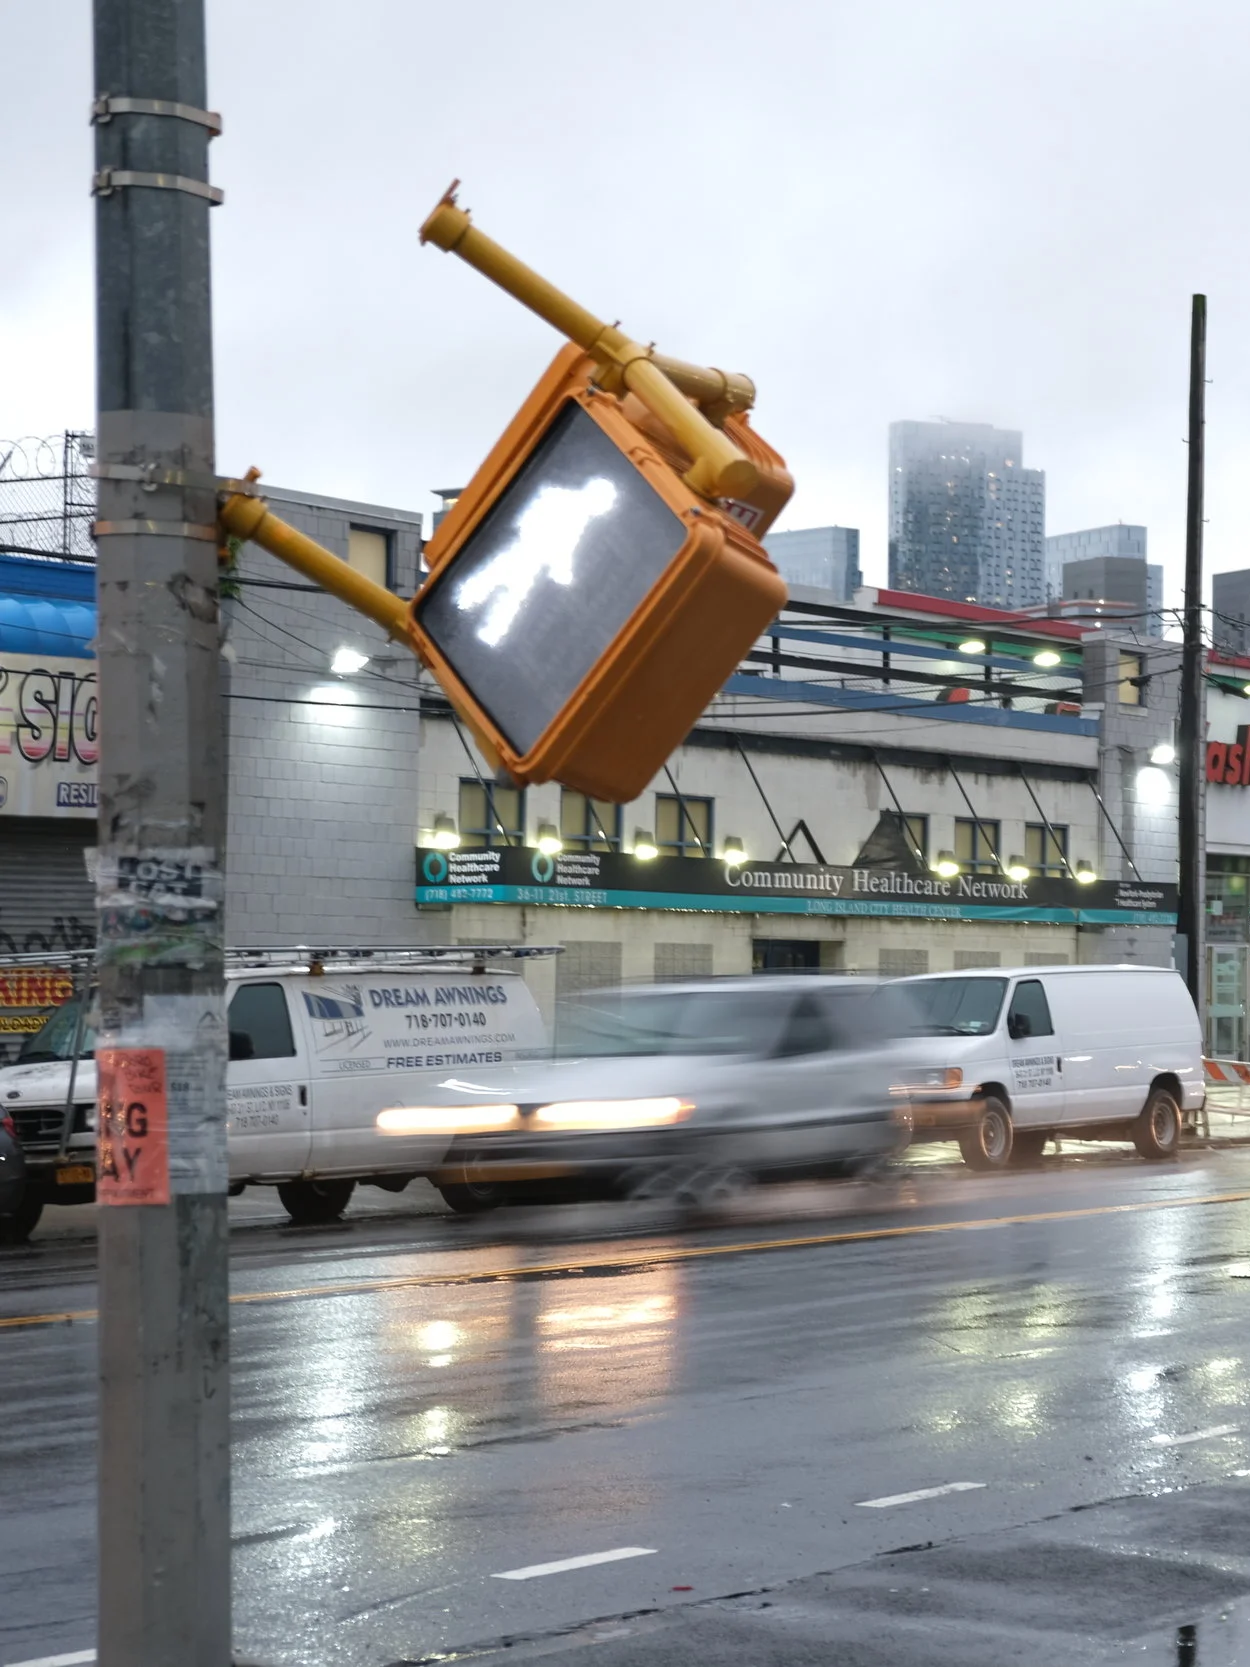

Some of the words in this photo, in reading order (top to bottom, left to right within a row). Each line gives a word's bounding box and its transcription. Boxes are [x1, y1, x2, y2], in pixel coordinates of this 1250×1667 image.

[58, 783, 99, 804] RESI
[449, 851, 500, 863] Community
[556, 854, 600, 866] Community
[449, 862, 500, 873] Healthcare
[556, 864, 600, 875] Healthcare
[449, 874, 488, 885] Network
[556, 876, 590, 886] Network
[724, 866, 844, 896] Community
[852, 869, 951, 896] Healthcare
[956, 876, 1028, 899] Network
[574, 890, 607, 903] STREET
[808, 901, 832, 912] LONG
[835, 901, 867, 914] ISLAND
[870, 903, 889, 914] CITY
[892, 904, 926, 916] HEALTH
[928, 906, 961, 918] CENTER
[369, 989, 430, 1008] DREAM
[434, 986, 507, 1006] AWNINGS
[383, 1033, 516, 1049] WWW.DREAMAWNINGS.COM
[387, 1055, 426, 1069] FREE
[427, 1051, 502, 1066] ESTIMATES
[275, 1085, 293, 1097] SIGNS
